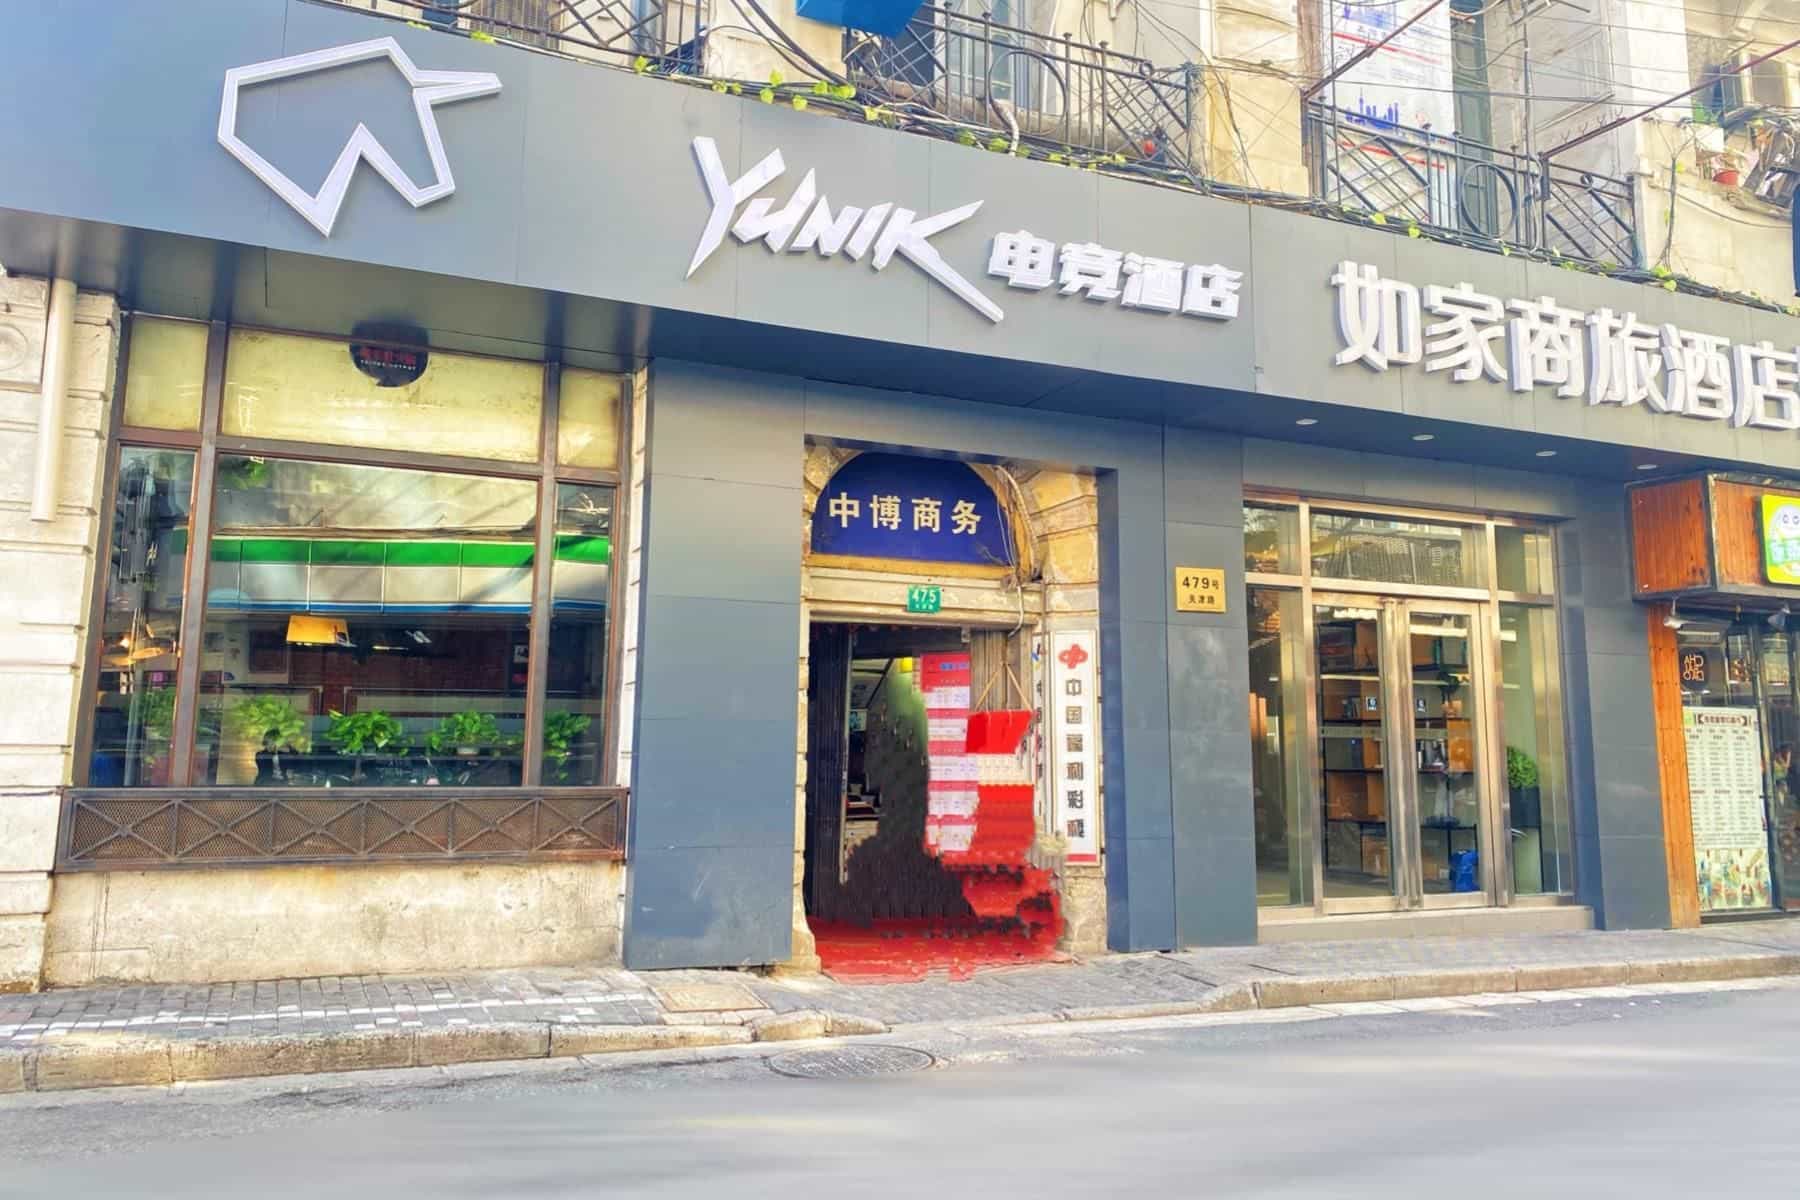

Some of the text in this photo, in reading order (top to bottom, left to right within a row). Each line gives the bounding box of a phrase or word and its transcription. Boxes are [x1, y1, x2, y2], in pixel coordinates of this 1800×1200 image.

[987, 229, 1244, 321] 电竞酒店
[1330, 259, 1800, 431] 如家商旅酒店
[828, 491, 982, 535] 中博商务
[911, 588, 937, 603] 475
[1065, 678, 1085, 839] 中国福利彩
